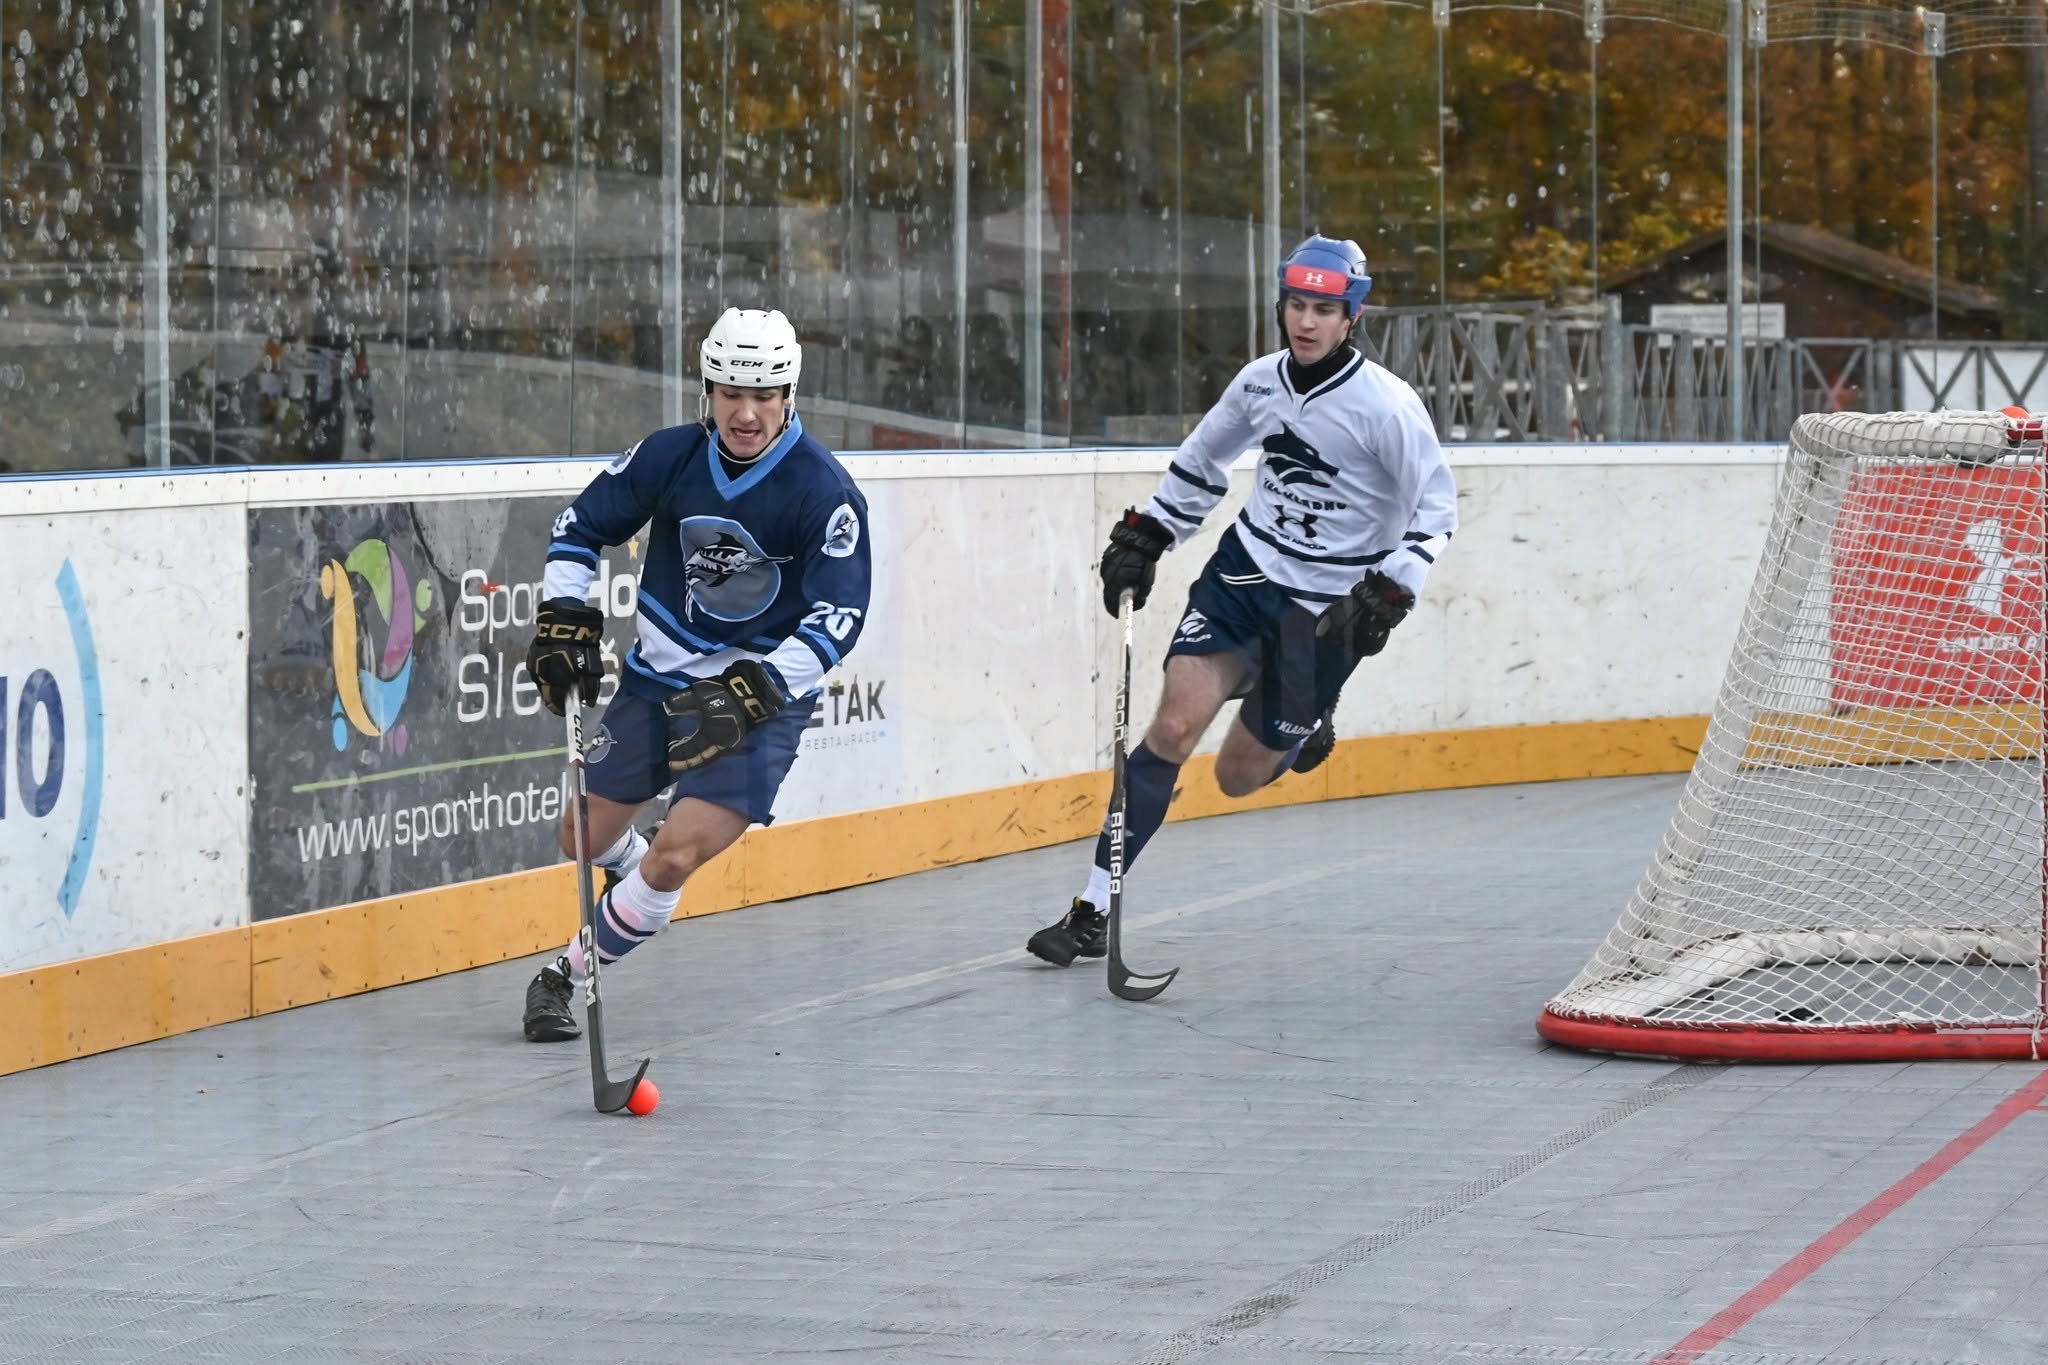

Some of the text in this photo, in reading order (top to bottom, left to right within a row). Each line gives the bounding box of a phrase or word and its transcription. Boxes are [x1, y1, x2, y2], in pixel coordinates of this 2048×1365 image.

[730, 360, 764, 368] CCM
[460, 569, 545, 644] Spor
[537, 623, 601, 642] CCM
[729, 675, 769, 723] CC
[0, 668, 65, 820] O
[573, 714, 585, 756] CCM
[298, 771, 573, 862] www.sporthotel
[581, 924, 597, 1007] CCM
